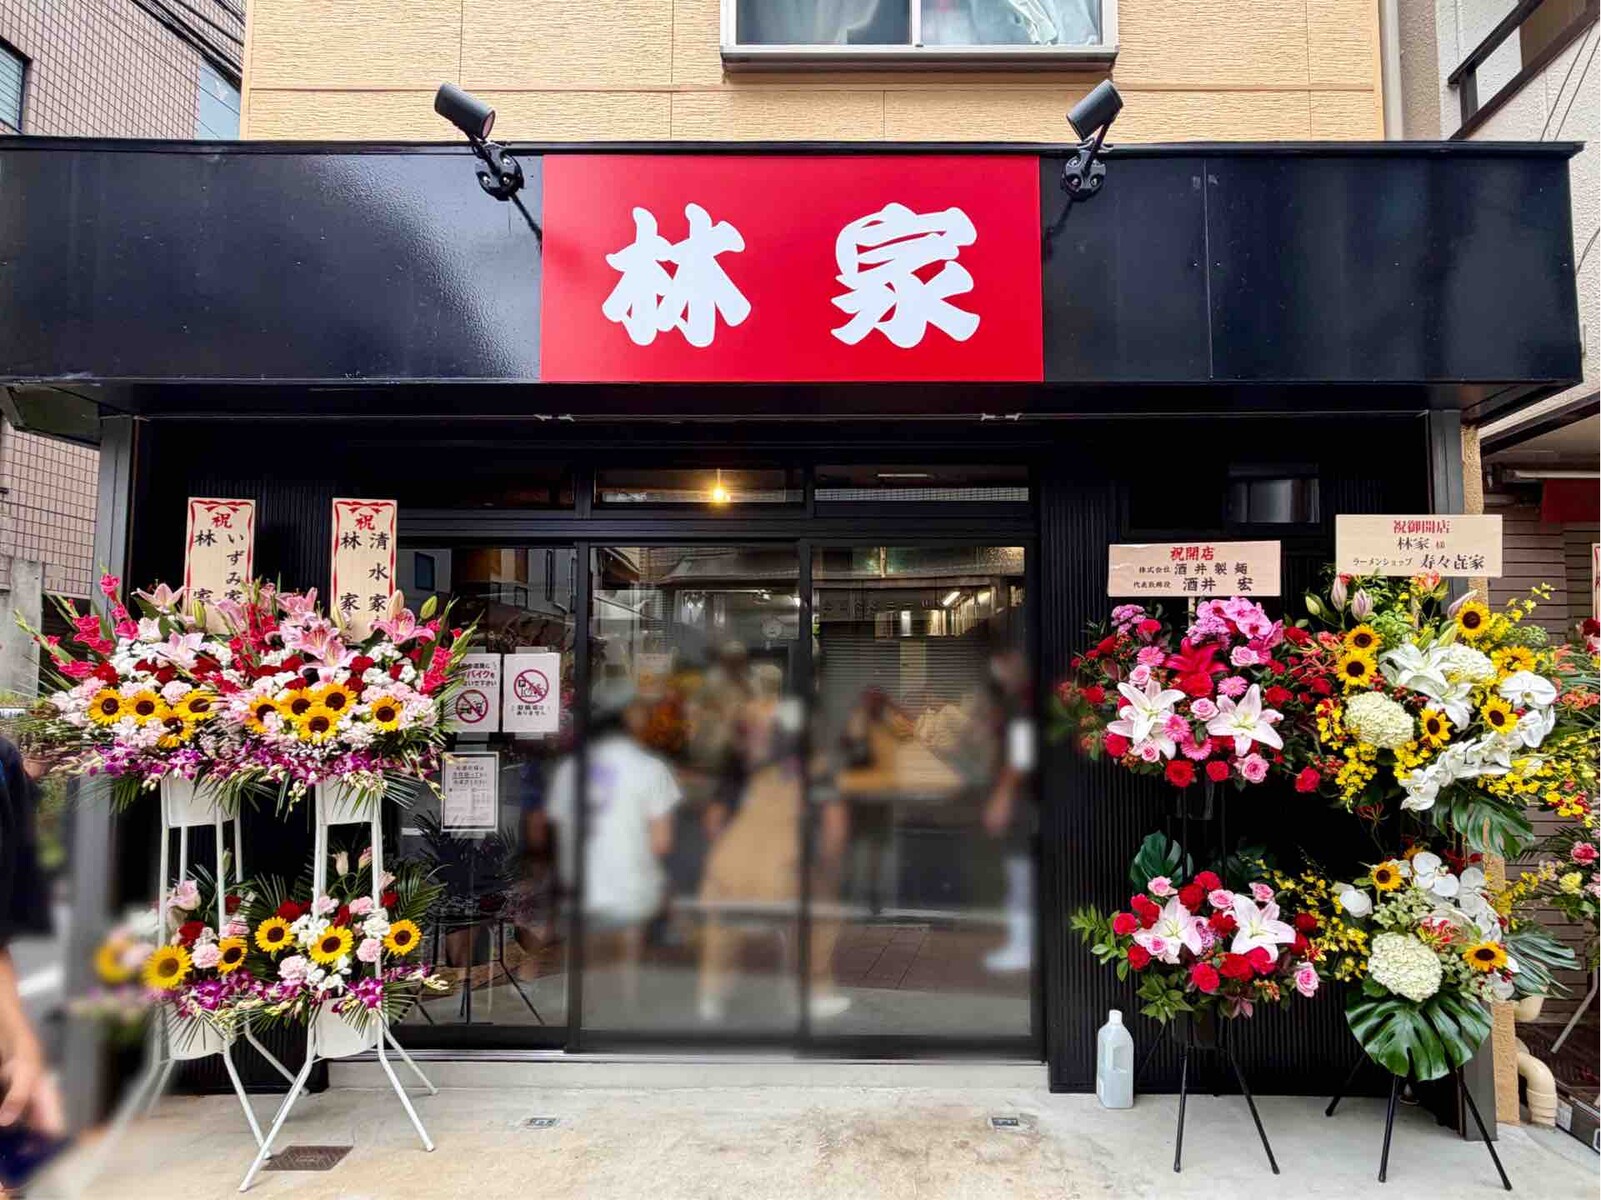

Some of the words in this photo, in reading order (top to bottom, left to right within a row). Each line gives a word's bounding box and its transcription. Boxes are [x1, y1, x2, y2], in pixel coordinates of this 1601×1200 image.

[602, 202, 981, 349] 林家
[211, 512, 232, 529] 祝
[355, 513, 375, 531] 祝
[1393, 519, 1450, 534] 祝御開店
[1397, 536, 1430, 550] 林家
[1170, 546, 1214, 561] 祝開店
[1352, 557, 1413, 566] ラーメンショップ
[340, 531, 361, 610] 林家
[1139, 566, 1171, 574] 株式会社
[1133, 581, 1172, 589] 代表取締役
[1182, 577, 1216, 592] 酒井
[1237, 576, 1254, 592] 宏
